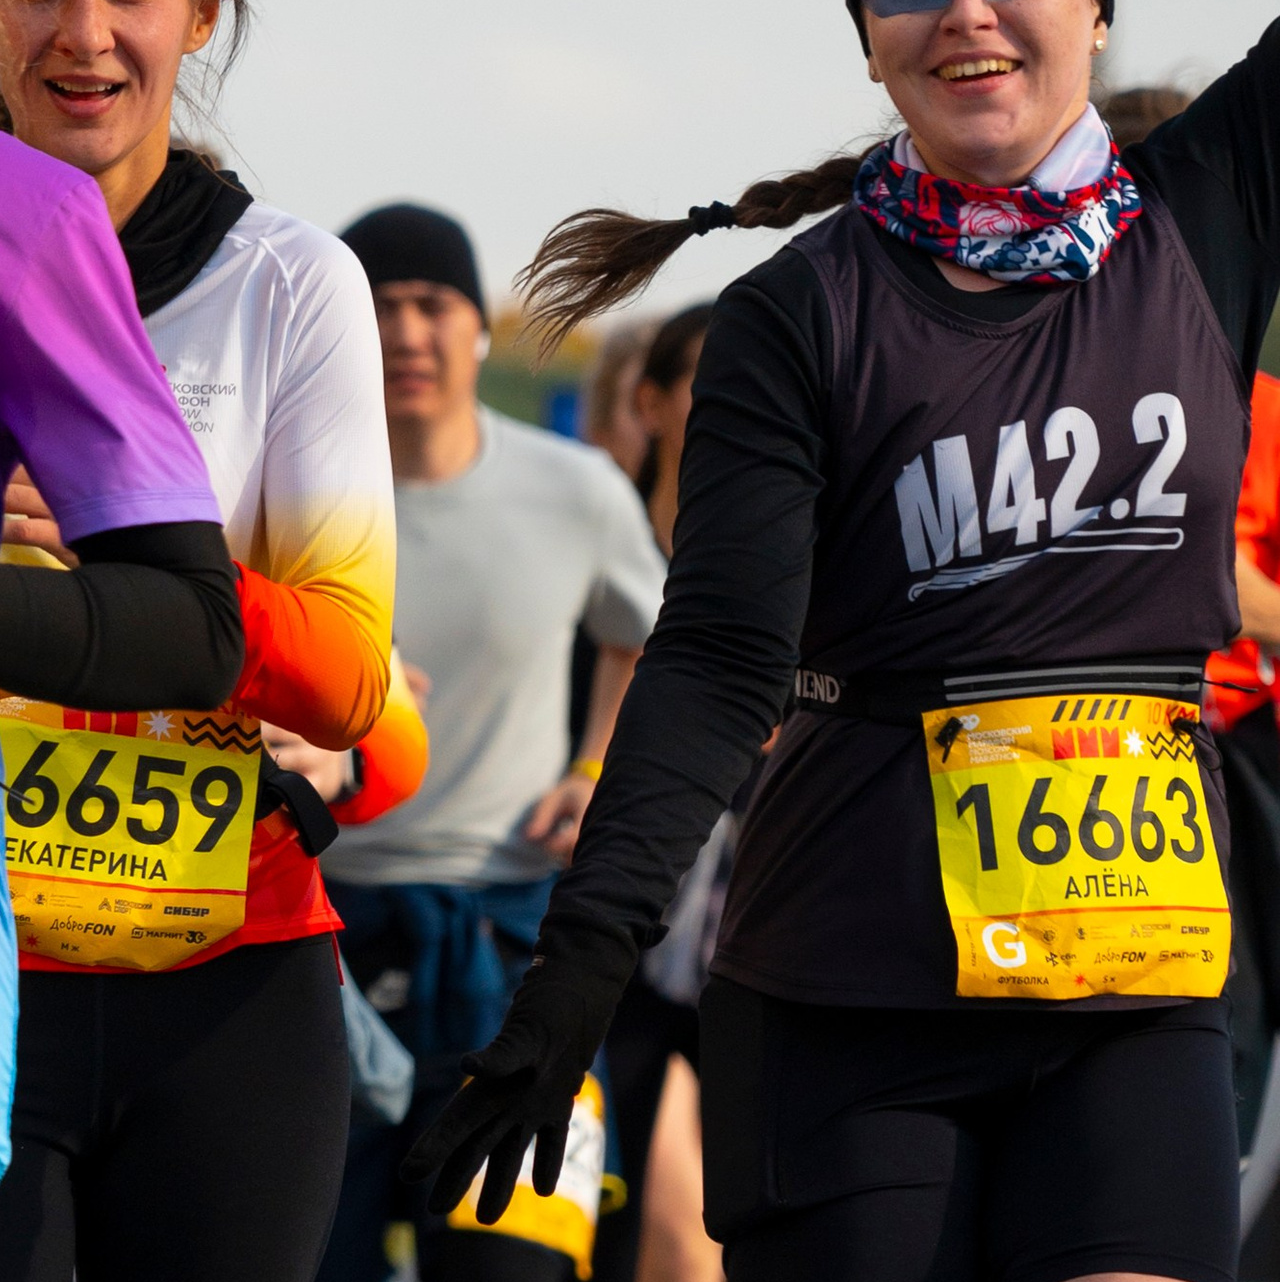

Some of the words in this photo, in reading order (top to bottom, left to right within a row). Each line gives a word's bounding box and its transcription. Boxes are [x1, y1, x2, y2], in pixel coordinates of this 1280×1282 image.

[170, 382, 237, 396] КОВСКИЙ
[894, 392, 1188, 573] M42.2
[6, 740, 243, 852] 6659
[956, 775, 1205, 872] 16663
[5, 837, 168, 881] ЕКАТЕРИНА
[1064, 868, 1149, 899] АЛЁНА
[163, 906, 210, 917] СИБУР
[982, 922, 1027, 969] G
[997, 976, 1049, 986] ФУТБОЛКА
